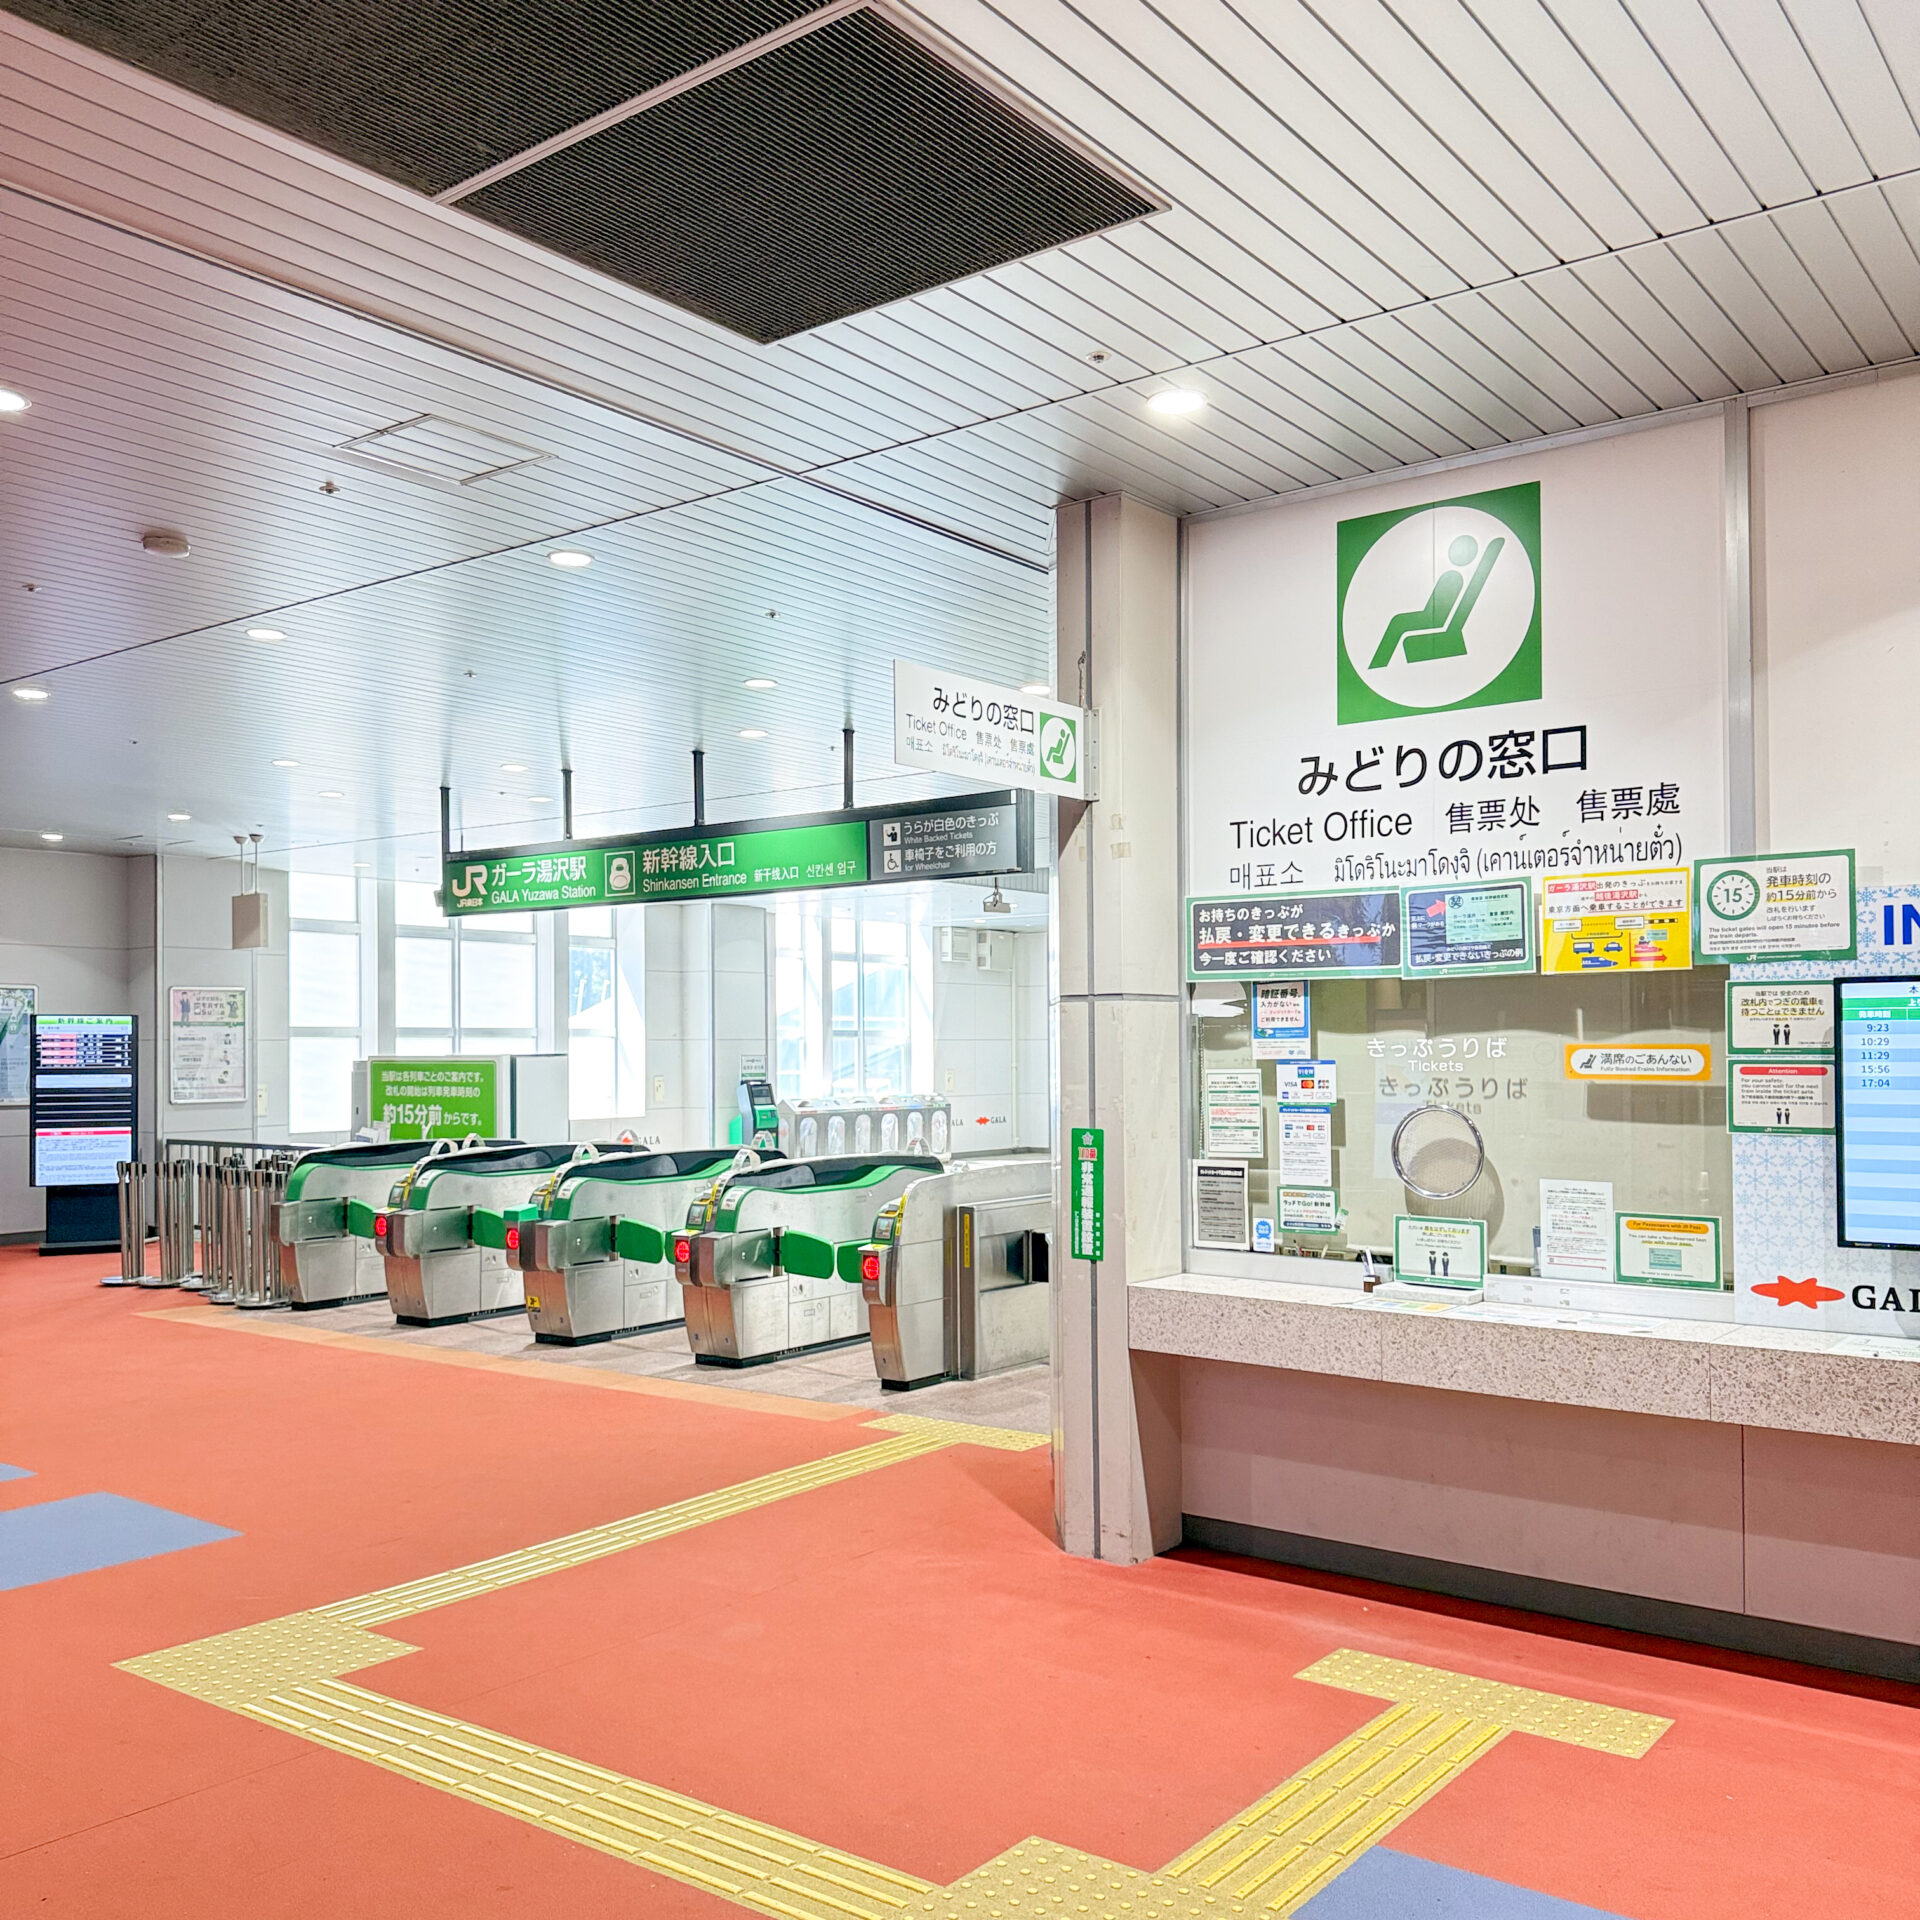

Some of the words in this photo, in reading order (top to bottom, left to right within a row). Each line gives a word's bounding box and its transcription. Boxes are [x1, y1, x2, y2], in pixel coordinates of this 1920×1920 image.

[933, 687, 1034, 735] みどりの窓口
[906, 713, 938, 735] Ticket
[939, 721, 967, 740] Office
[1297, 724, 1587, 797] みどりの窓口
[1445, 795, 1541, 834] 售票处
[1575, 782, 1681, 823] 售票處
[903, 811, 999, 835] うらが白色のきっぷ
[1229, 817, 1312, 849] Ticket
[1323, 807, 1413, 842] Office
[642, 842, 735, 874] 新幹線入口
[904, 841, 997, 862] 車椅子をご利用の方
[492, 856, 586, 886] ガーラ湯沢駅
[806, 863, 834, 878] 신칸센
[837, 860, 856, 876] 입구
[1229, 860, 1304, 891] 매표소
[452, 864, 488, 897] JR
[642, 876, 700, 894] Shinkansen
[702, 872, 748, 888] Entrance
[1766, 872, 1832, 888] 発車時刻の
[492, 890, 519, 904] GALA
[522, 888, 560, 900] Yuzawa
[562, 885, 596, 898] Station
[1724, 888, 1743, 904] 15
[1766, 888, 1838, 902] 約15分前から
[1199, 904, 1304, 923] お持ちのきっぷが
[1766, 904, 1816, 914] 改札を行います
[1199, 922, 1396, 945] 払戻・変更できるきっぷか
[1199, 948, 1332, 966] 今一度ご確認ください
[1741, 1007, 1824, 1016] 待つことはできません
[1866, 1024, 1890, 1032] 9:23
[1366, 1037, 1508, 1058] きっぷうりば
[1861, 1038, 1890, 1046] 10:29
[1600, 1053, 1692, 1065] 満席のごあんない
[1861, 1051, 1890, 1060] 11:29
[1408, 1060, 1464, 1072] Tickets
[1861, 1065, 1890, 1074] 15:56
[1861, 1079, 1890, 1087] 17:04
[383, 1104, 482, 1126] 約15分前からです。
